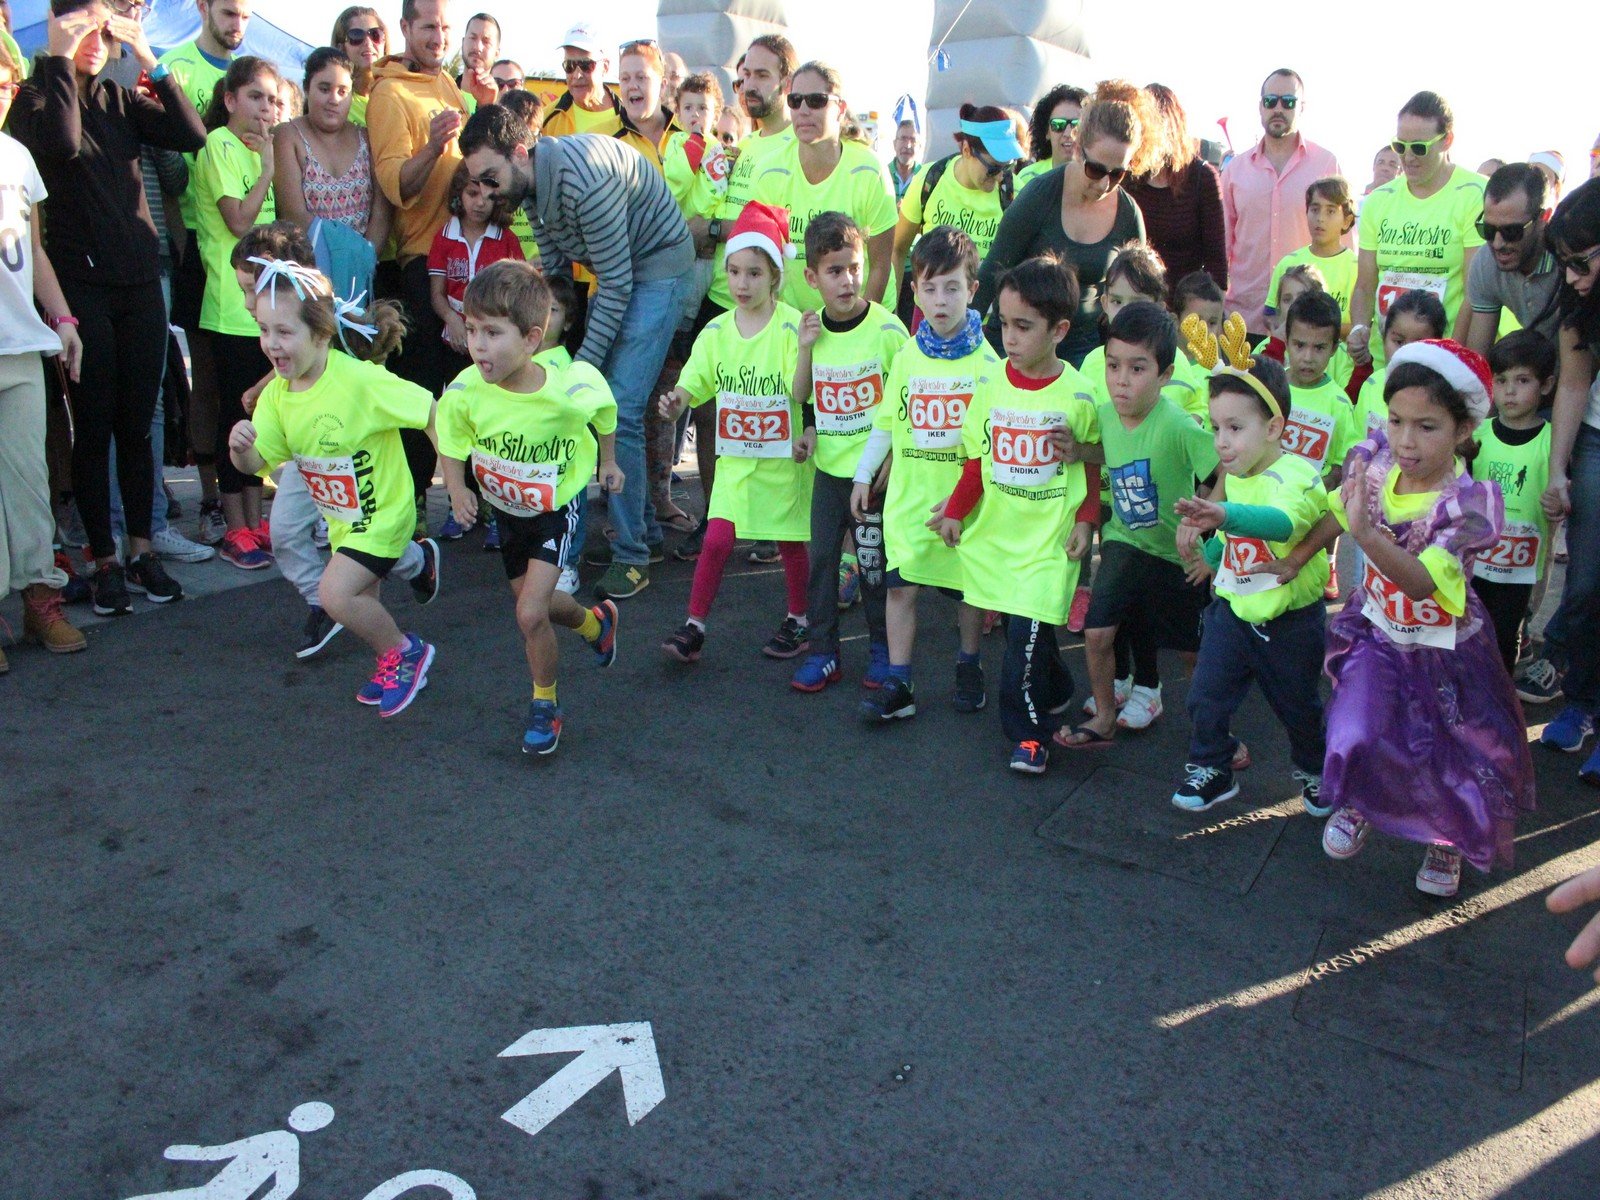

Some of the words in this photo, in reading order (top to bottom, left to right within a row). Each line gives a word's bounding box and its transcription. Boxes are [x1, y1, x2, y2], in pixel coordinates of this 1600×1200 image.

[1377, 218, 1398, 245] San
[1396, 222, 1452, 246] Silvestre
[821, 381, 876, 413] 669
[725, 413, 782, 440] 632
[835, 411, 866, 421] AGUSTIN
[911, 398, 966, 428] 609
[499, 431, 578, 463] Silvestre
[997, 431, 1054, 464] 600
[1010, 466, 1040, 475] ENDIKA
[483, 473, 545, 513] 603
[1028, 491, 1036, 500] EL
[1484, 564, 1514, 574] JEROME
